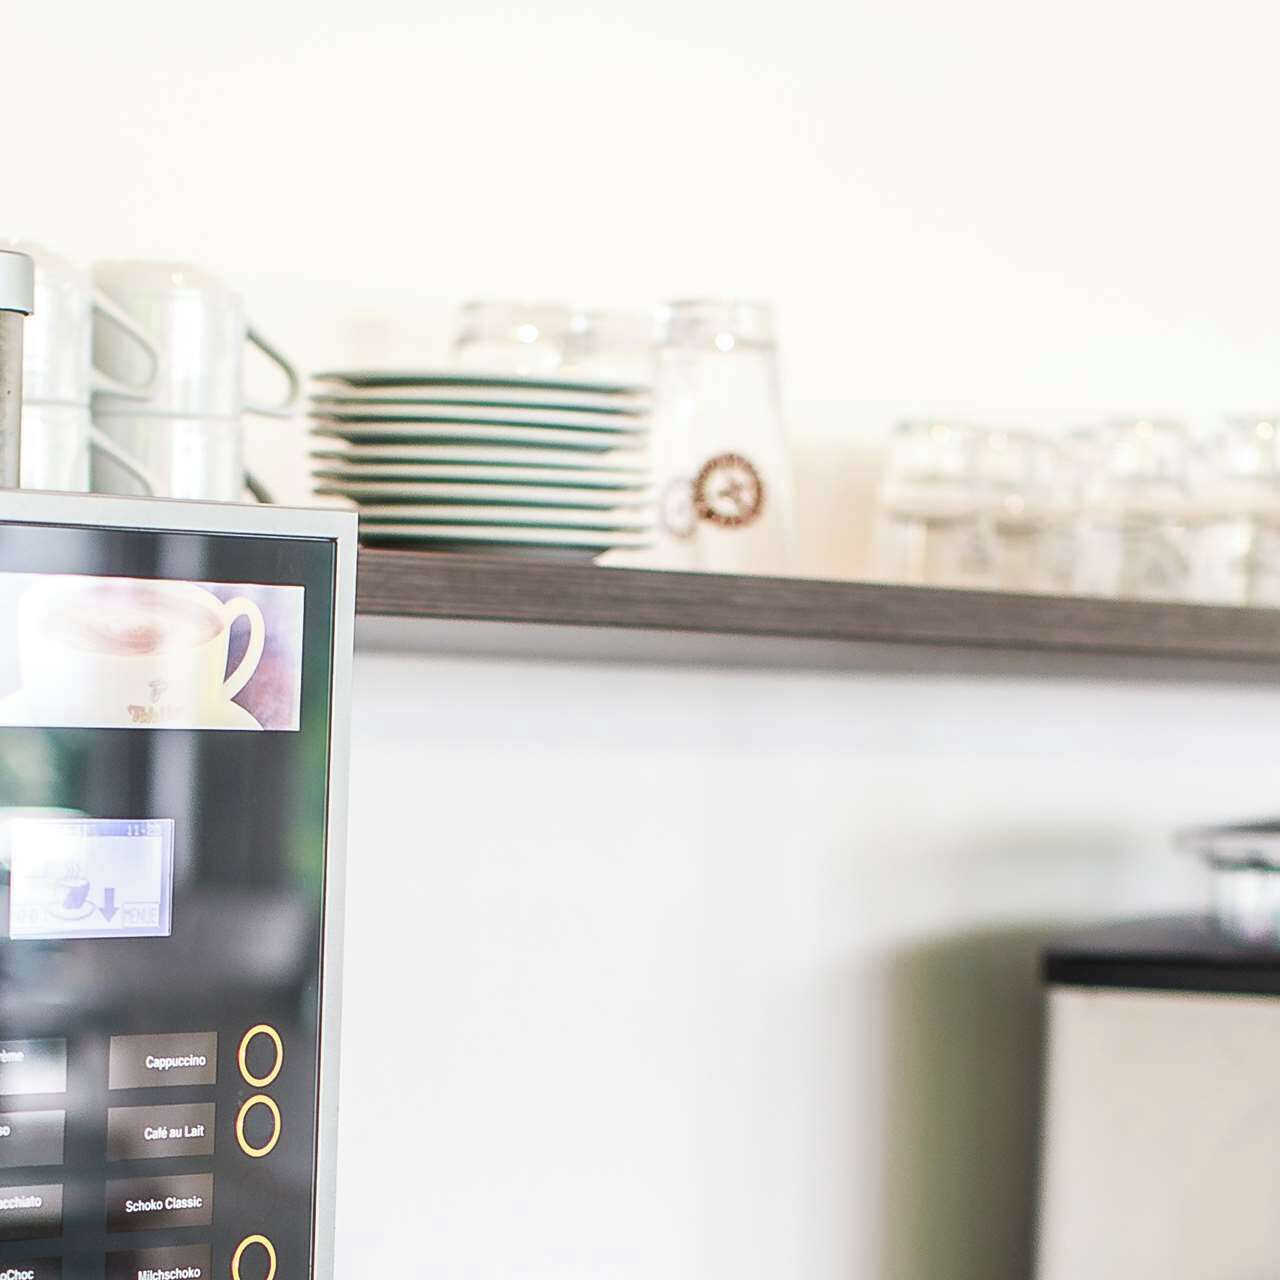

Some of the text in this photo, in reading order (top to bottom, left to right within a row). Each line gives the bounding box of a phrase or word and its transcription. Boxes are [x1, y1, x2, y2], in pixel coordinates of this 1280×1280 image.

[146, 1054, 206, 1070] Cappuccino
[144, 1125, 204, 1139] Café au Lait
[125, 1196, 202, 1213] Schoko Classic
